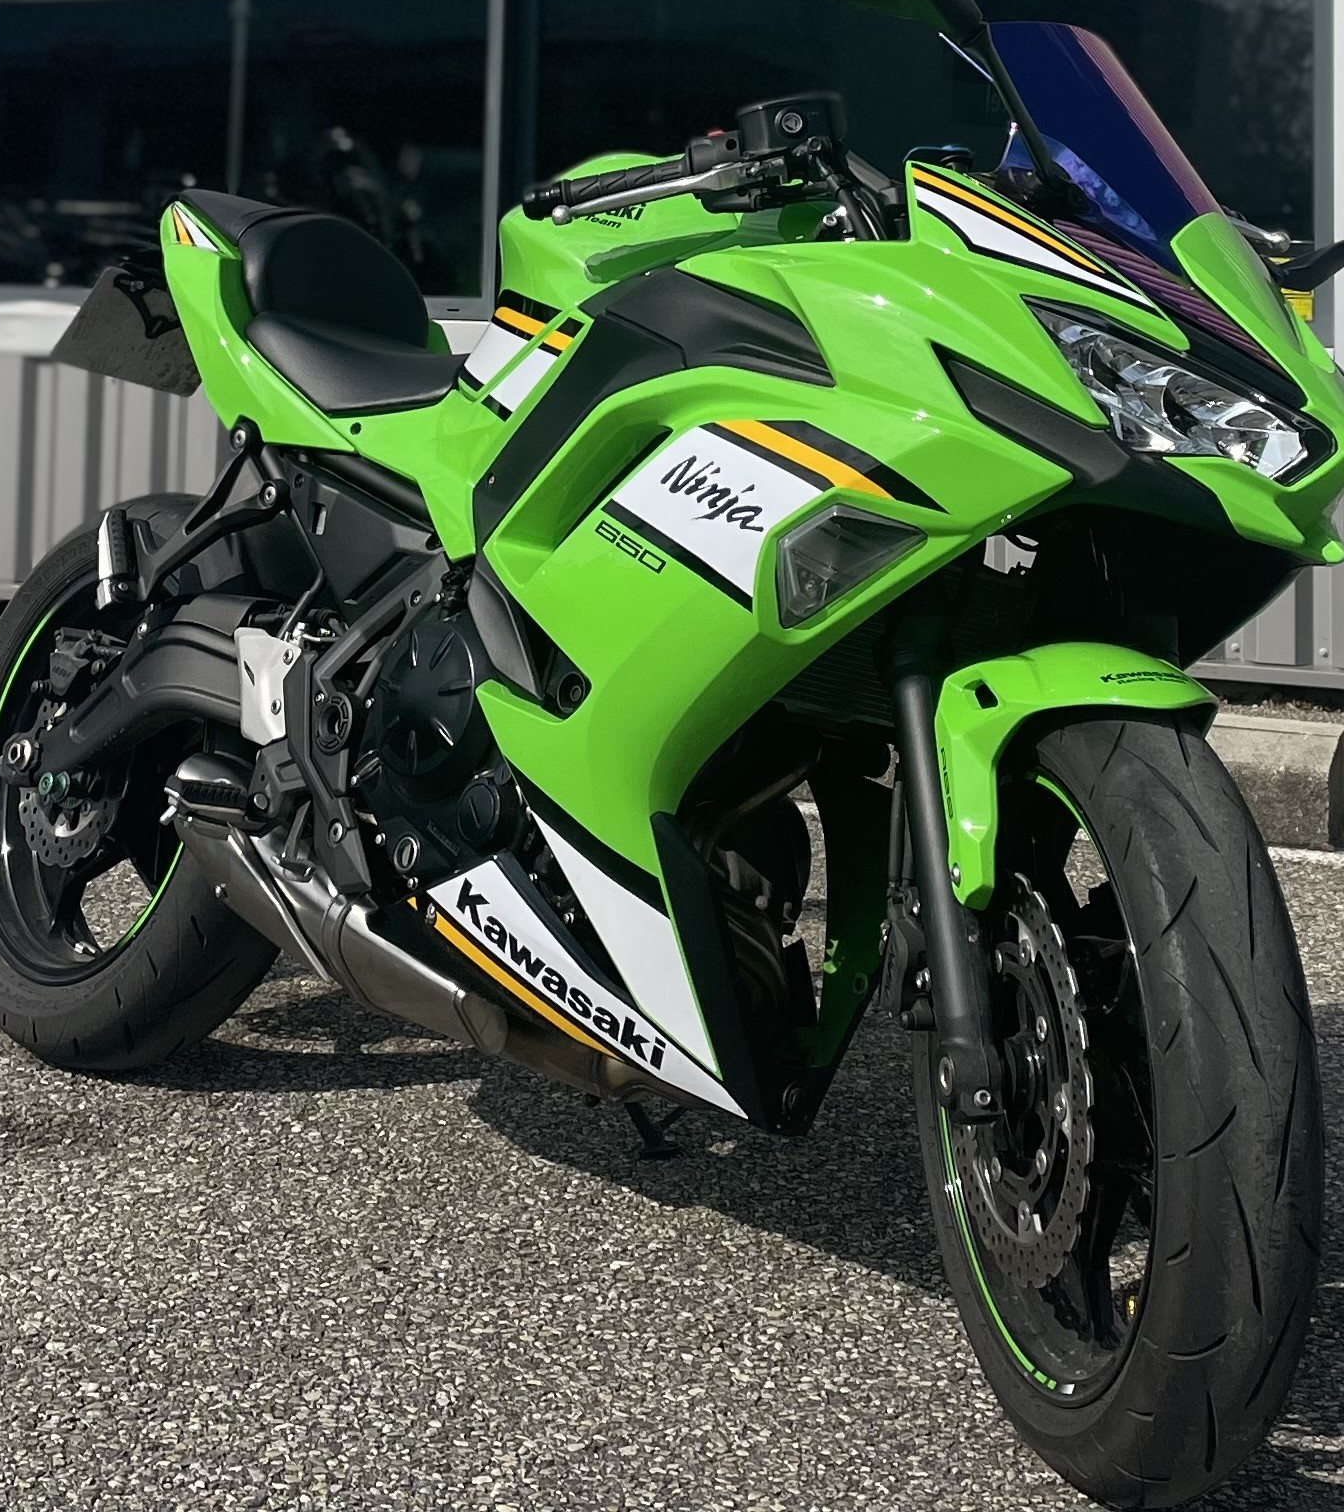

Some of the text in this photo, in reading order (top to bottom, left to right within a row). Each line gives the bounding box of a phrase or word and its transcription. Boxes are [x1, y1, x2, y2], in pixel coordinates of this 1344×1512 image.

[659, 454, 764, 533] Ninja
[594, 520, 667, 574] 650
[456, 877, 667, 1071] Kawasaki
